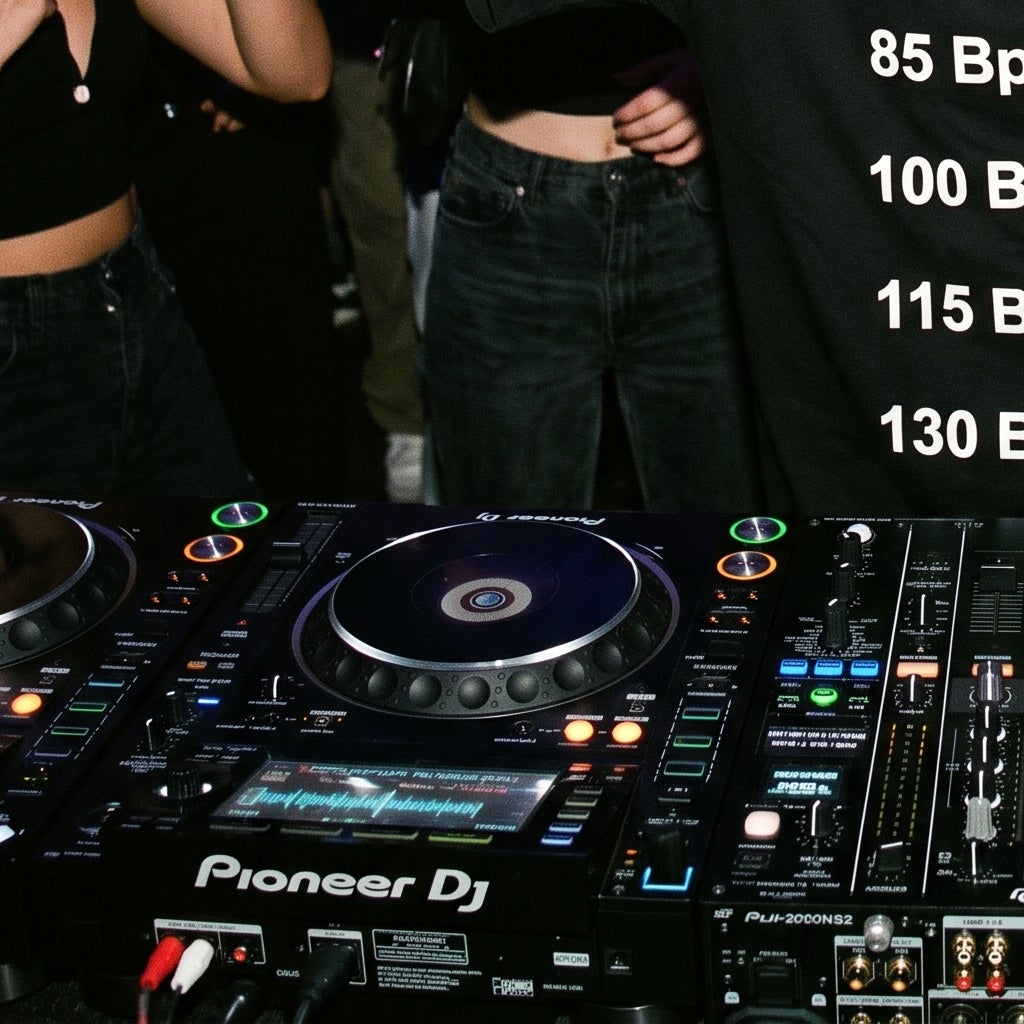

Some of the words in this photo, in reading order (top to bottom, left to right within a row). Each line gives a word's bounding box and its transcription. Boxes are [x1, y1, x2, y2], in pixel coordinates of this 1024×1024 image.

[870, 28, 934, 83] 85
[869, 154, 968, 207] 100
[877, 278, 974, 333] 115
[880, 404, 978, 459] 130
[506, 513, 606, 526] Pioneer
[194, 854, 417, 898] Pioneer
